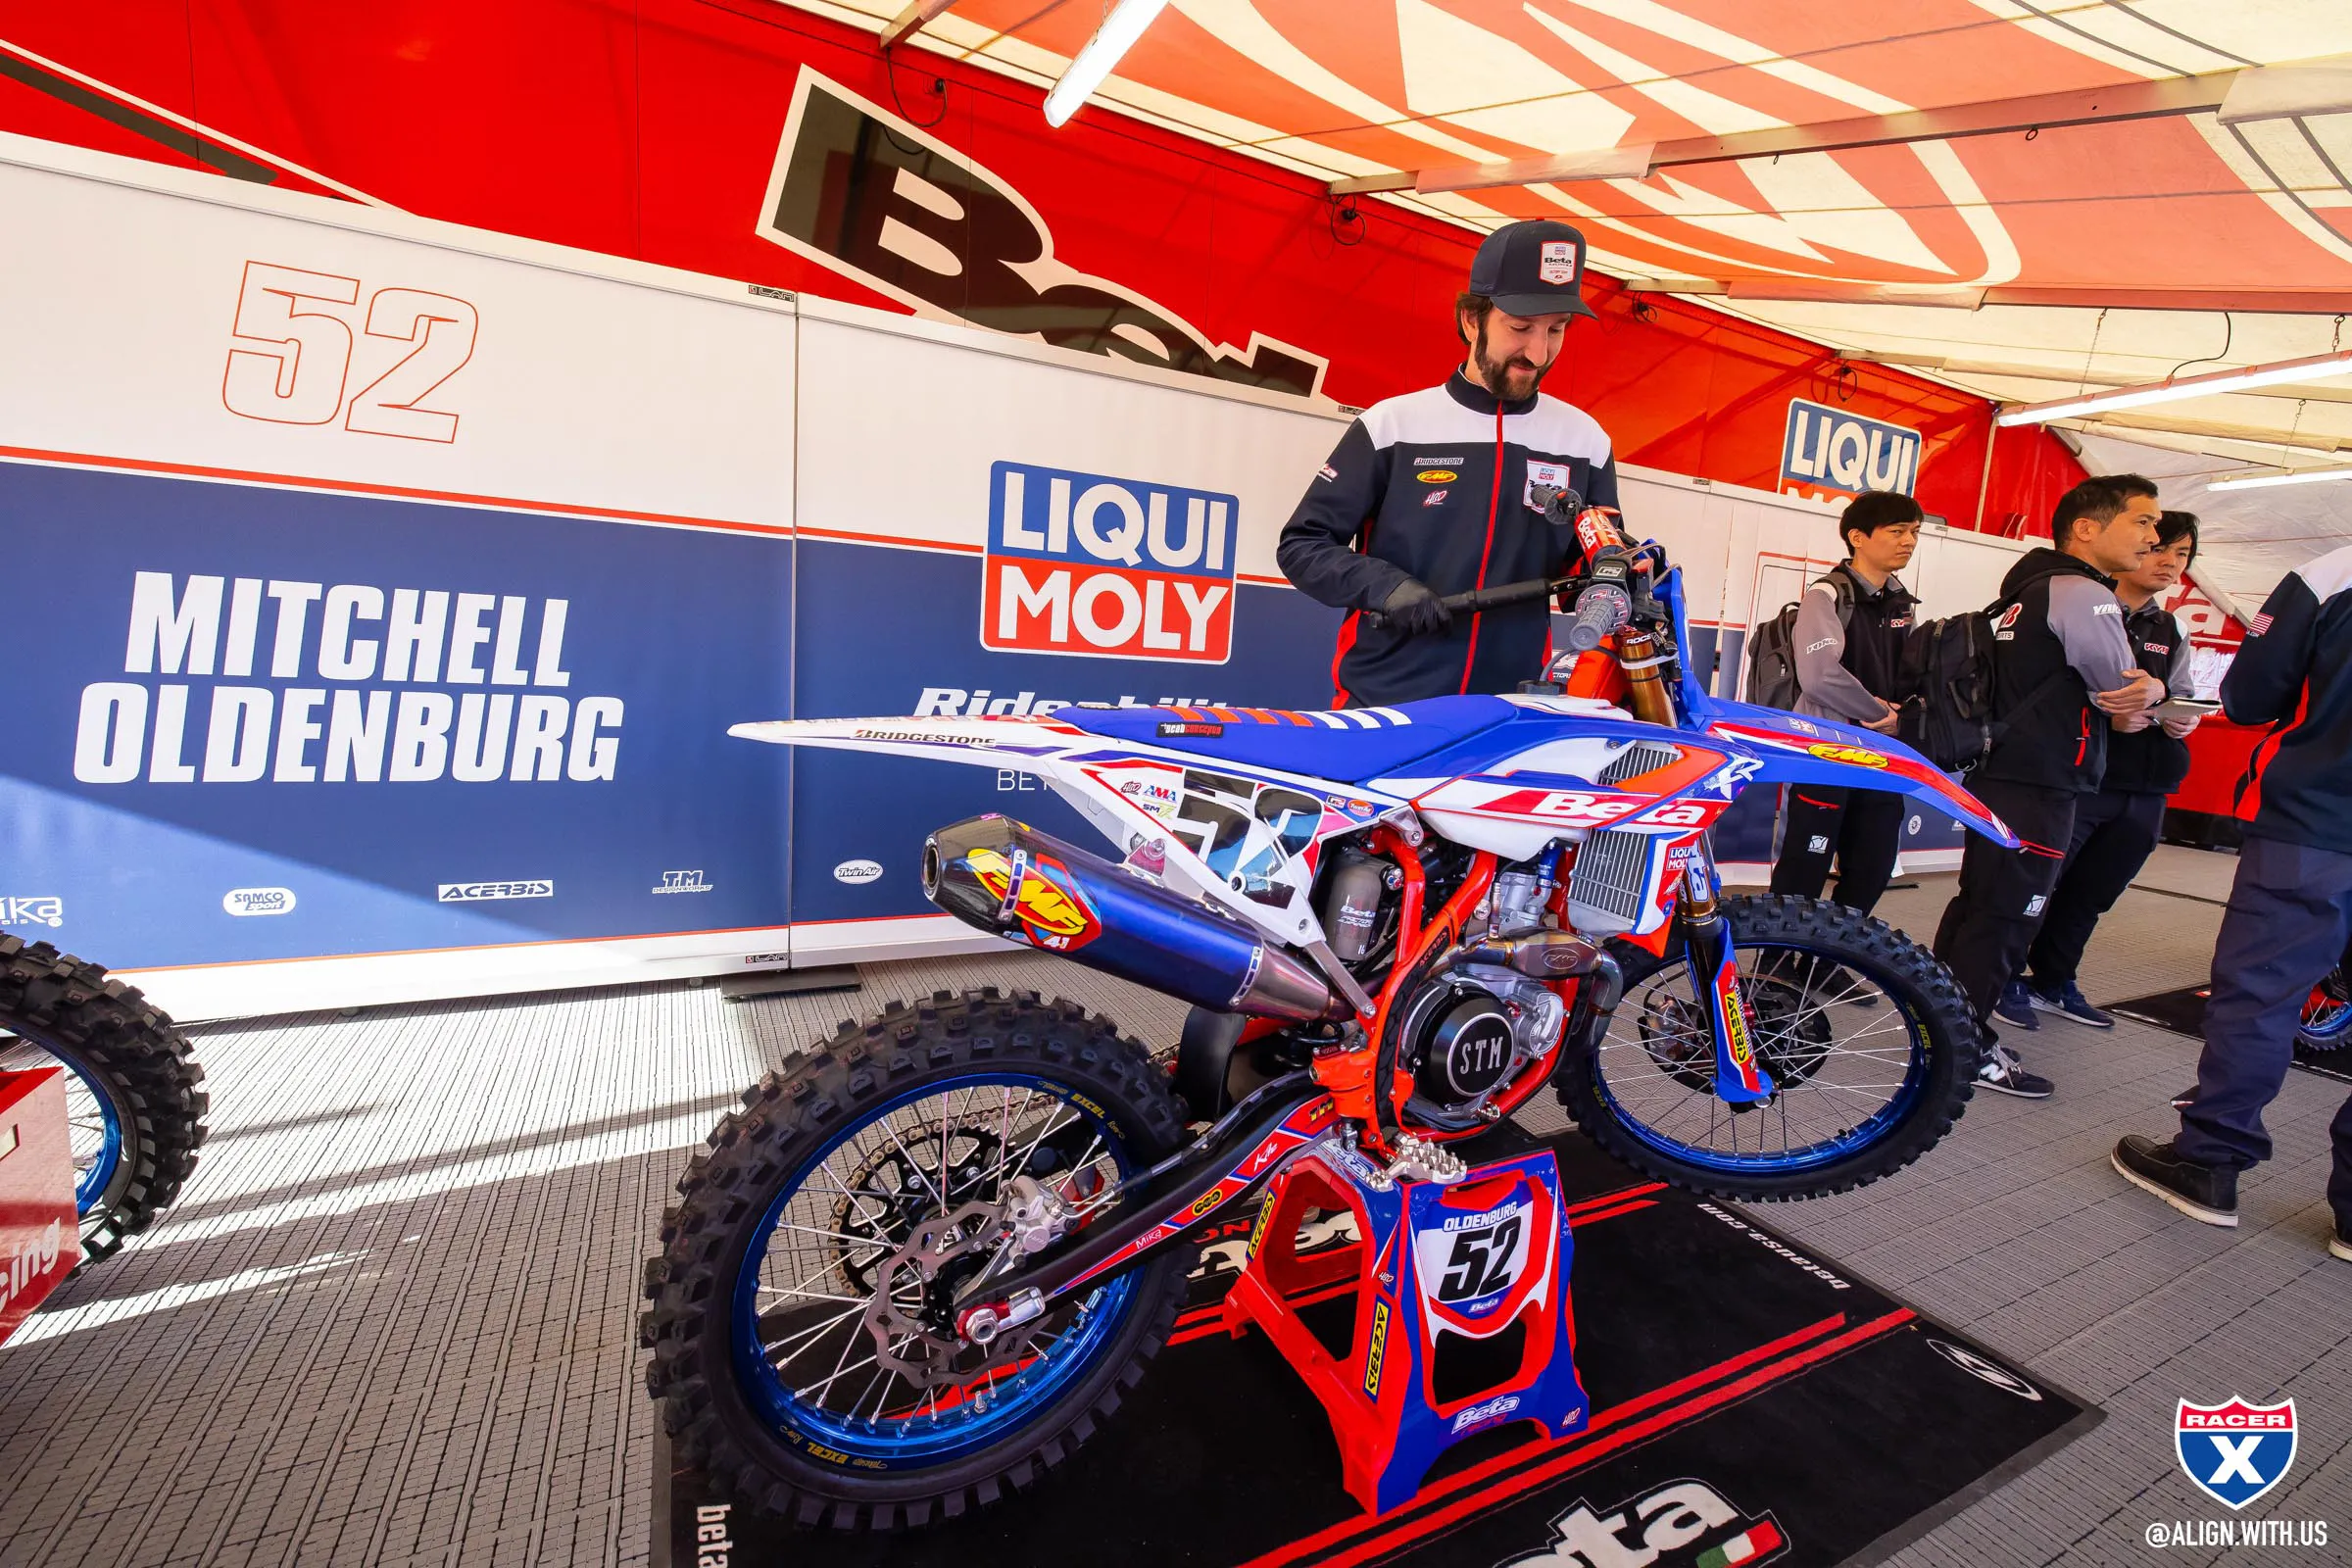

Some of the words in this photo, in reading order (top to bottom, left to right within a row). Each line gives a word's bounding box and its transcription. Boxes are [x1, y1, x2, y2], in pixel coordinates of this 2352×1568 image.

[222, 261, 478, 444] 52
[1414, 457, 1464, 466] BRIDGESTONE
[1790, 410, 1915, 496] LIQUI
[1003, 470, 1229, 570] LIQUI
[1578, 516, 1597, 549] Beta
[998, 564, 1230, 652] MOLY
[123, 570, 570, 687] MITCHELL
[74, 682, 624, 784] OLDENBURG
[854, 728, 996, 746] BRIDGESTONE
[1811, 745, 1889, 767] FMF
[1144, 785, 1177, 802] AMA
[1531, 792, 1706, 824] Beta
[662, 871, 703, 887] TM
[1668, 859, 1689, 869] MOL
[441, 882, 551, 900] ACERBIS
[966, 853, 1088, 929] FMF
[1459, 1036, 1503, 1075] STM
[1070, 1093, 1105, 1119] EXCEL
[1443, 1201, 1518, 1232] OLDENBURG
[1438, 1216, 1522, 1301] 52
[1697, 1202, 1852, 1290] betausa.com
[1469, 1296, 1500, 1314] Beta
[1368, 1304, 1386, 1390] ACERBIS
[1451, 1395, 1520, 1435] Beta
[807, 1442, 850, 1464] EXCEL
[697, 1503, 733, 1568] beta
